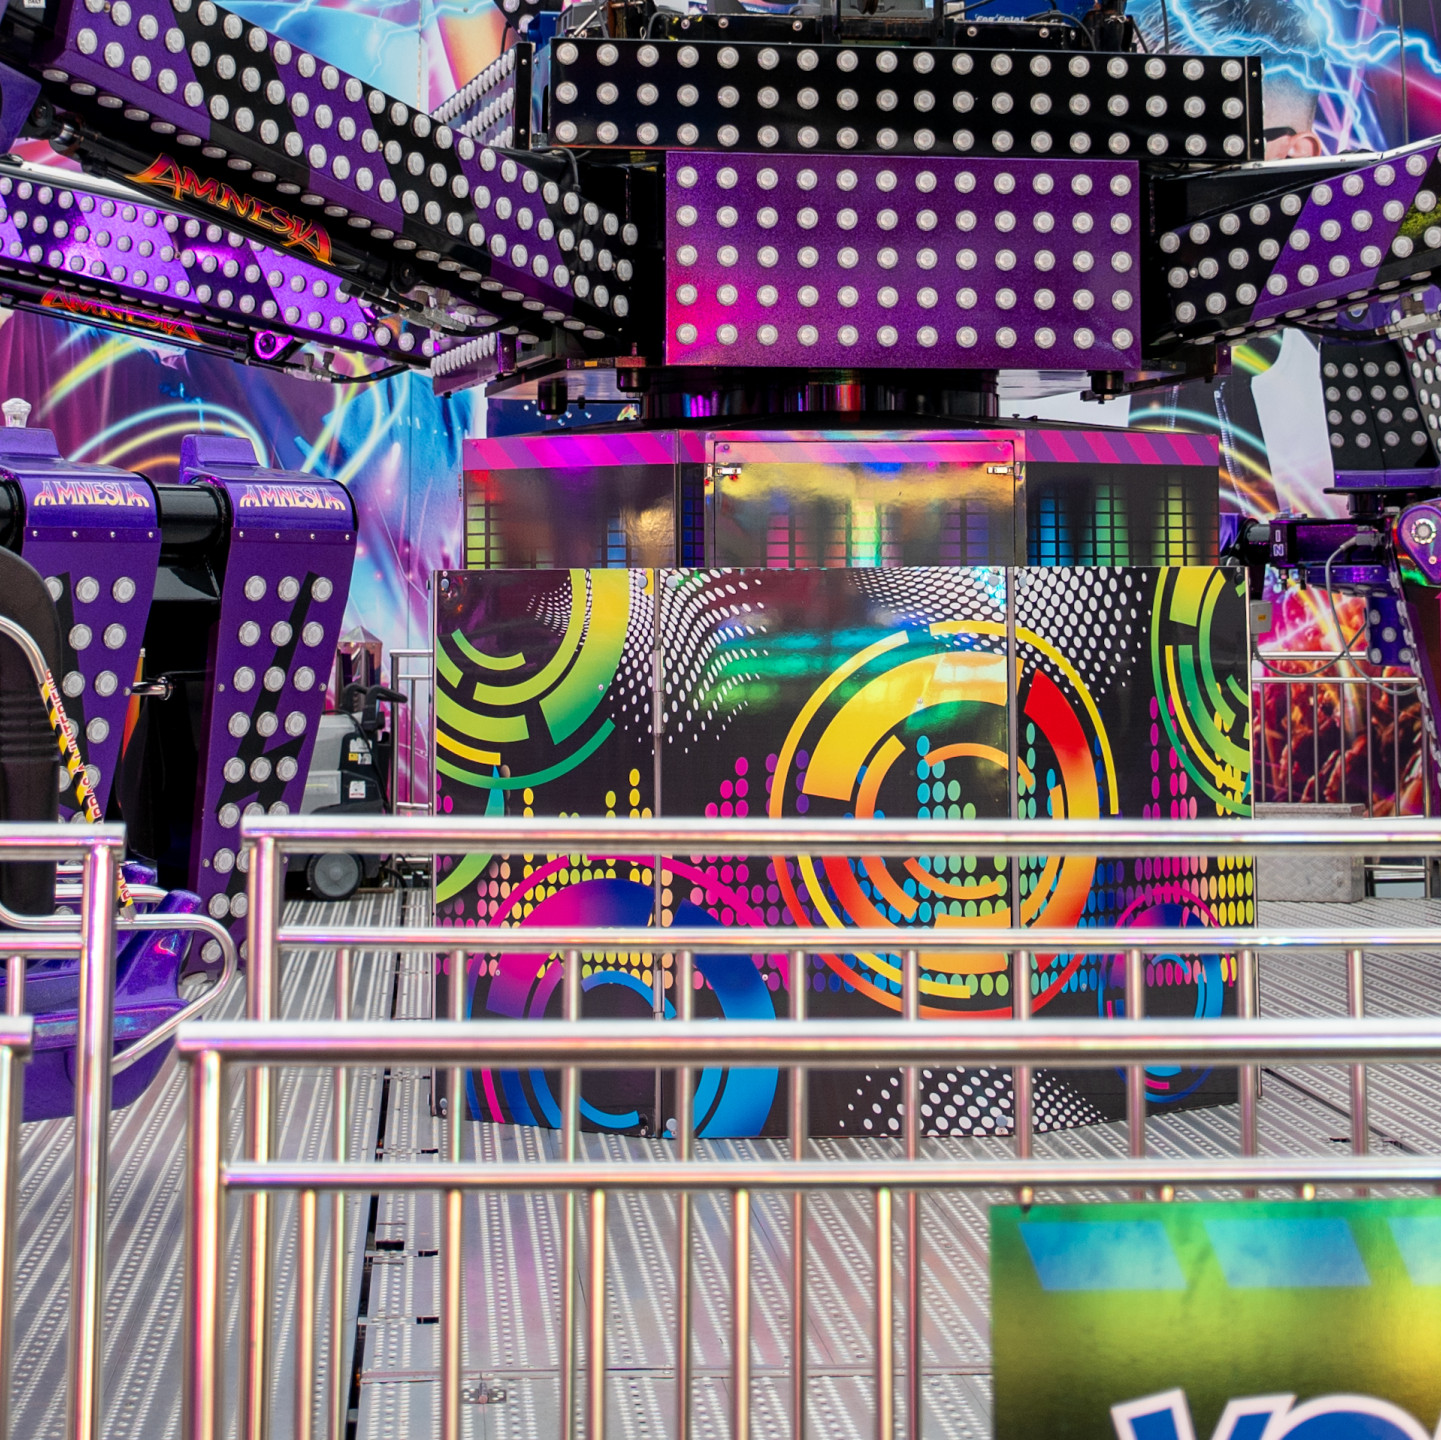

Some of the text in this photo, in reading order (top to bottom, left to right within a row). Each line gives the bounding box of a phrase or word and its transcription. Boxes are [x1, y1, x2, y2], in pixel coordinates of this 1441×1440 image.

[125, 152, 336, 266] AMNESIA
[40, 285, 202, 342] AMNESIA
[34, 481, 150, 508] AMNESIA
[239, 484, 346, 511] AMNESIA
[1273, 529, 1284, 556] IN
